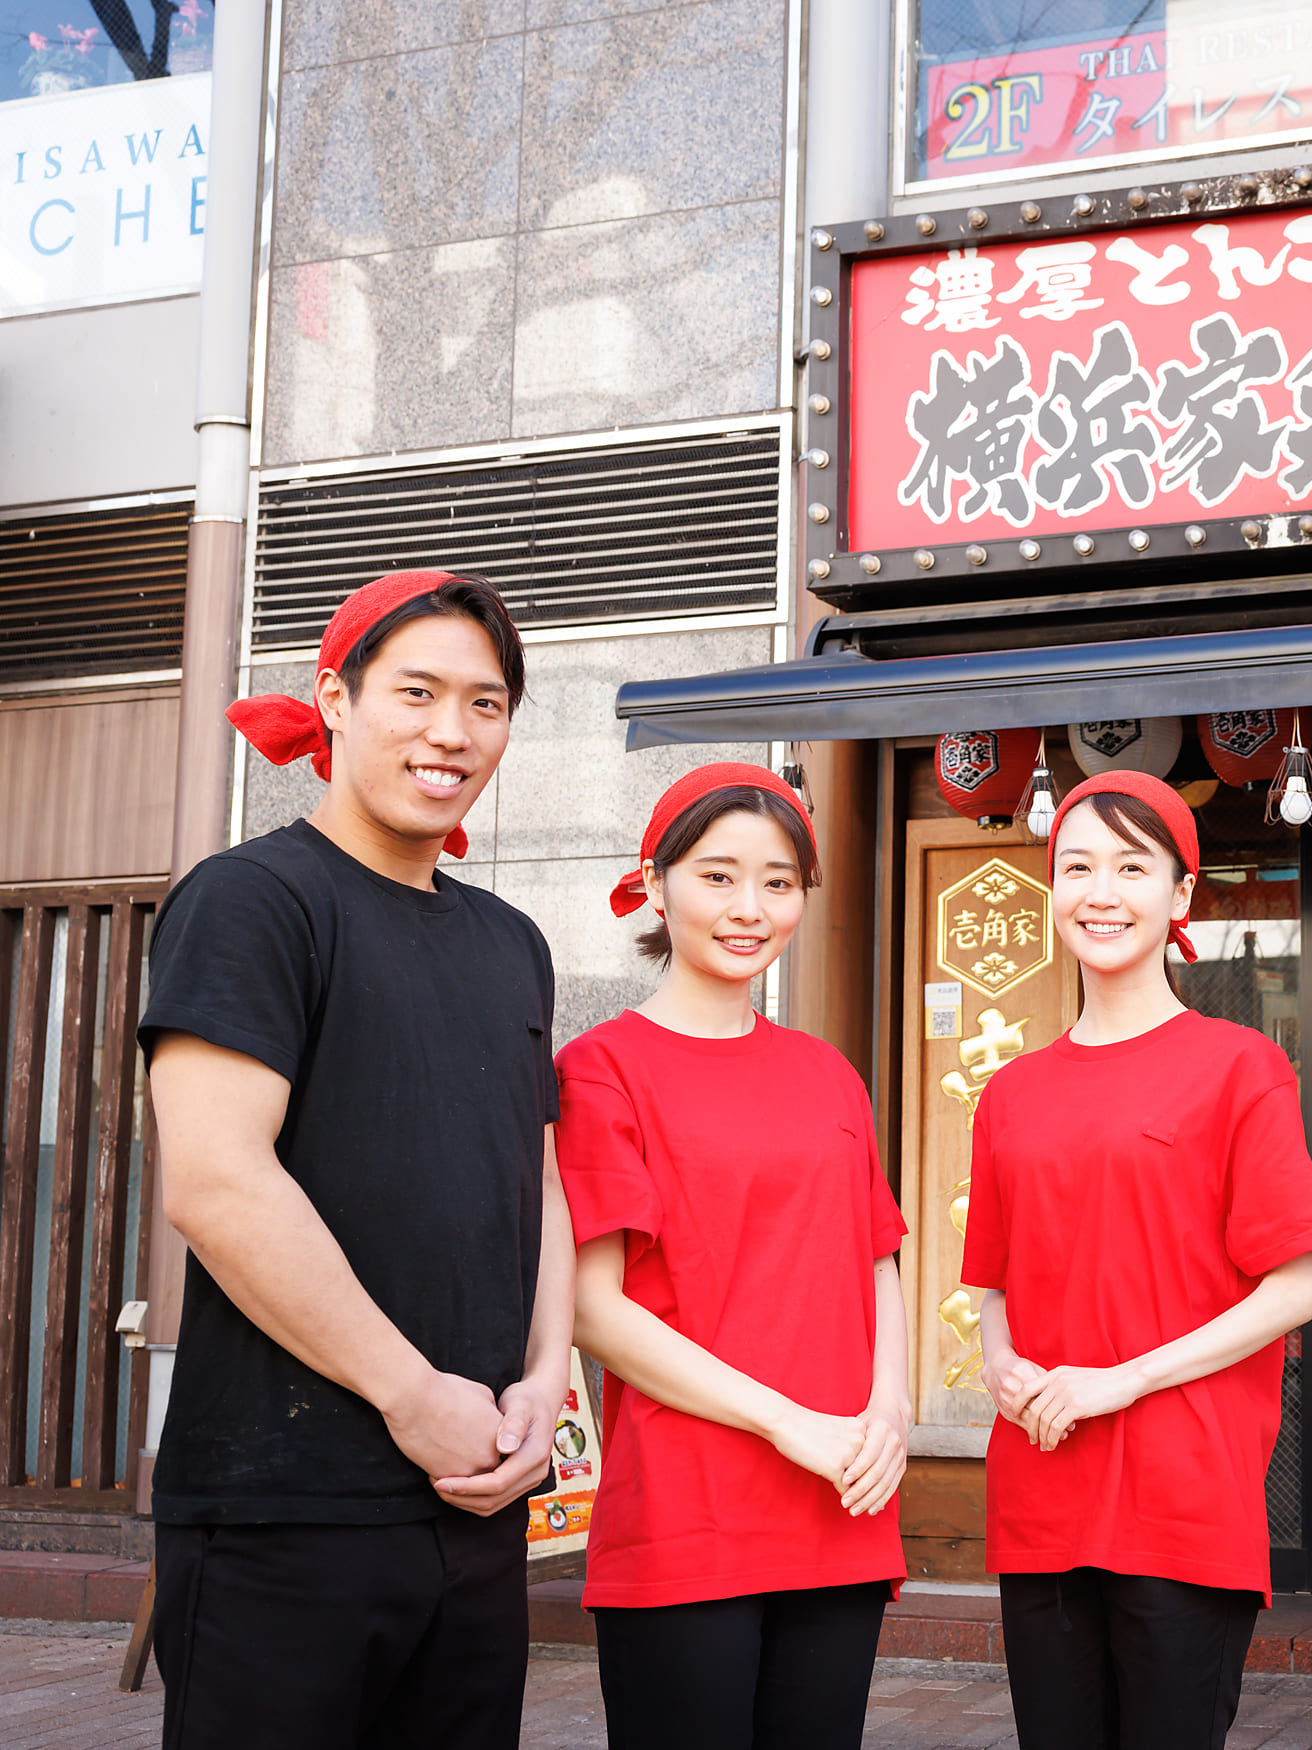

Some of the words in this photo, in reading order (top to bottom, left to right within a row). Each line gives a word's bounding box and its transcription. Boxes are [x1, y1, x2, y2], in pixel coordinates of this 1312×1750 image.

[943, 72, 1042, 162] 2F
[14, 123, 206, 184] ISAWA
[949, 908, 1041, 949] 壱角家
